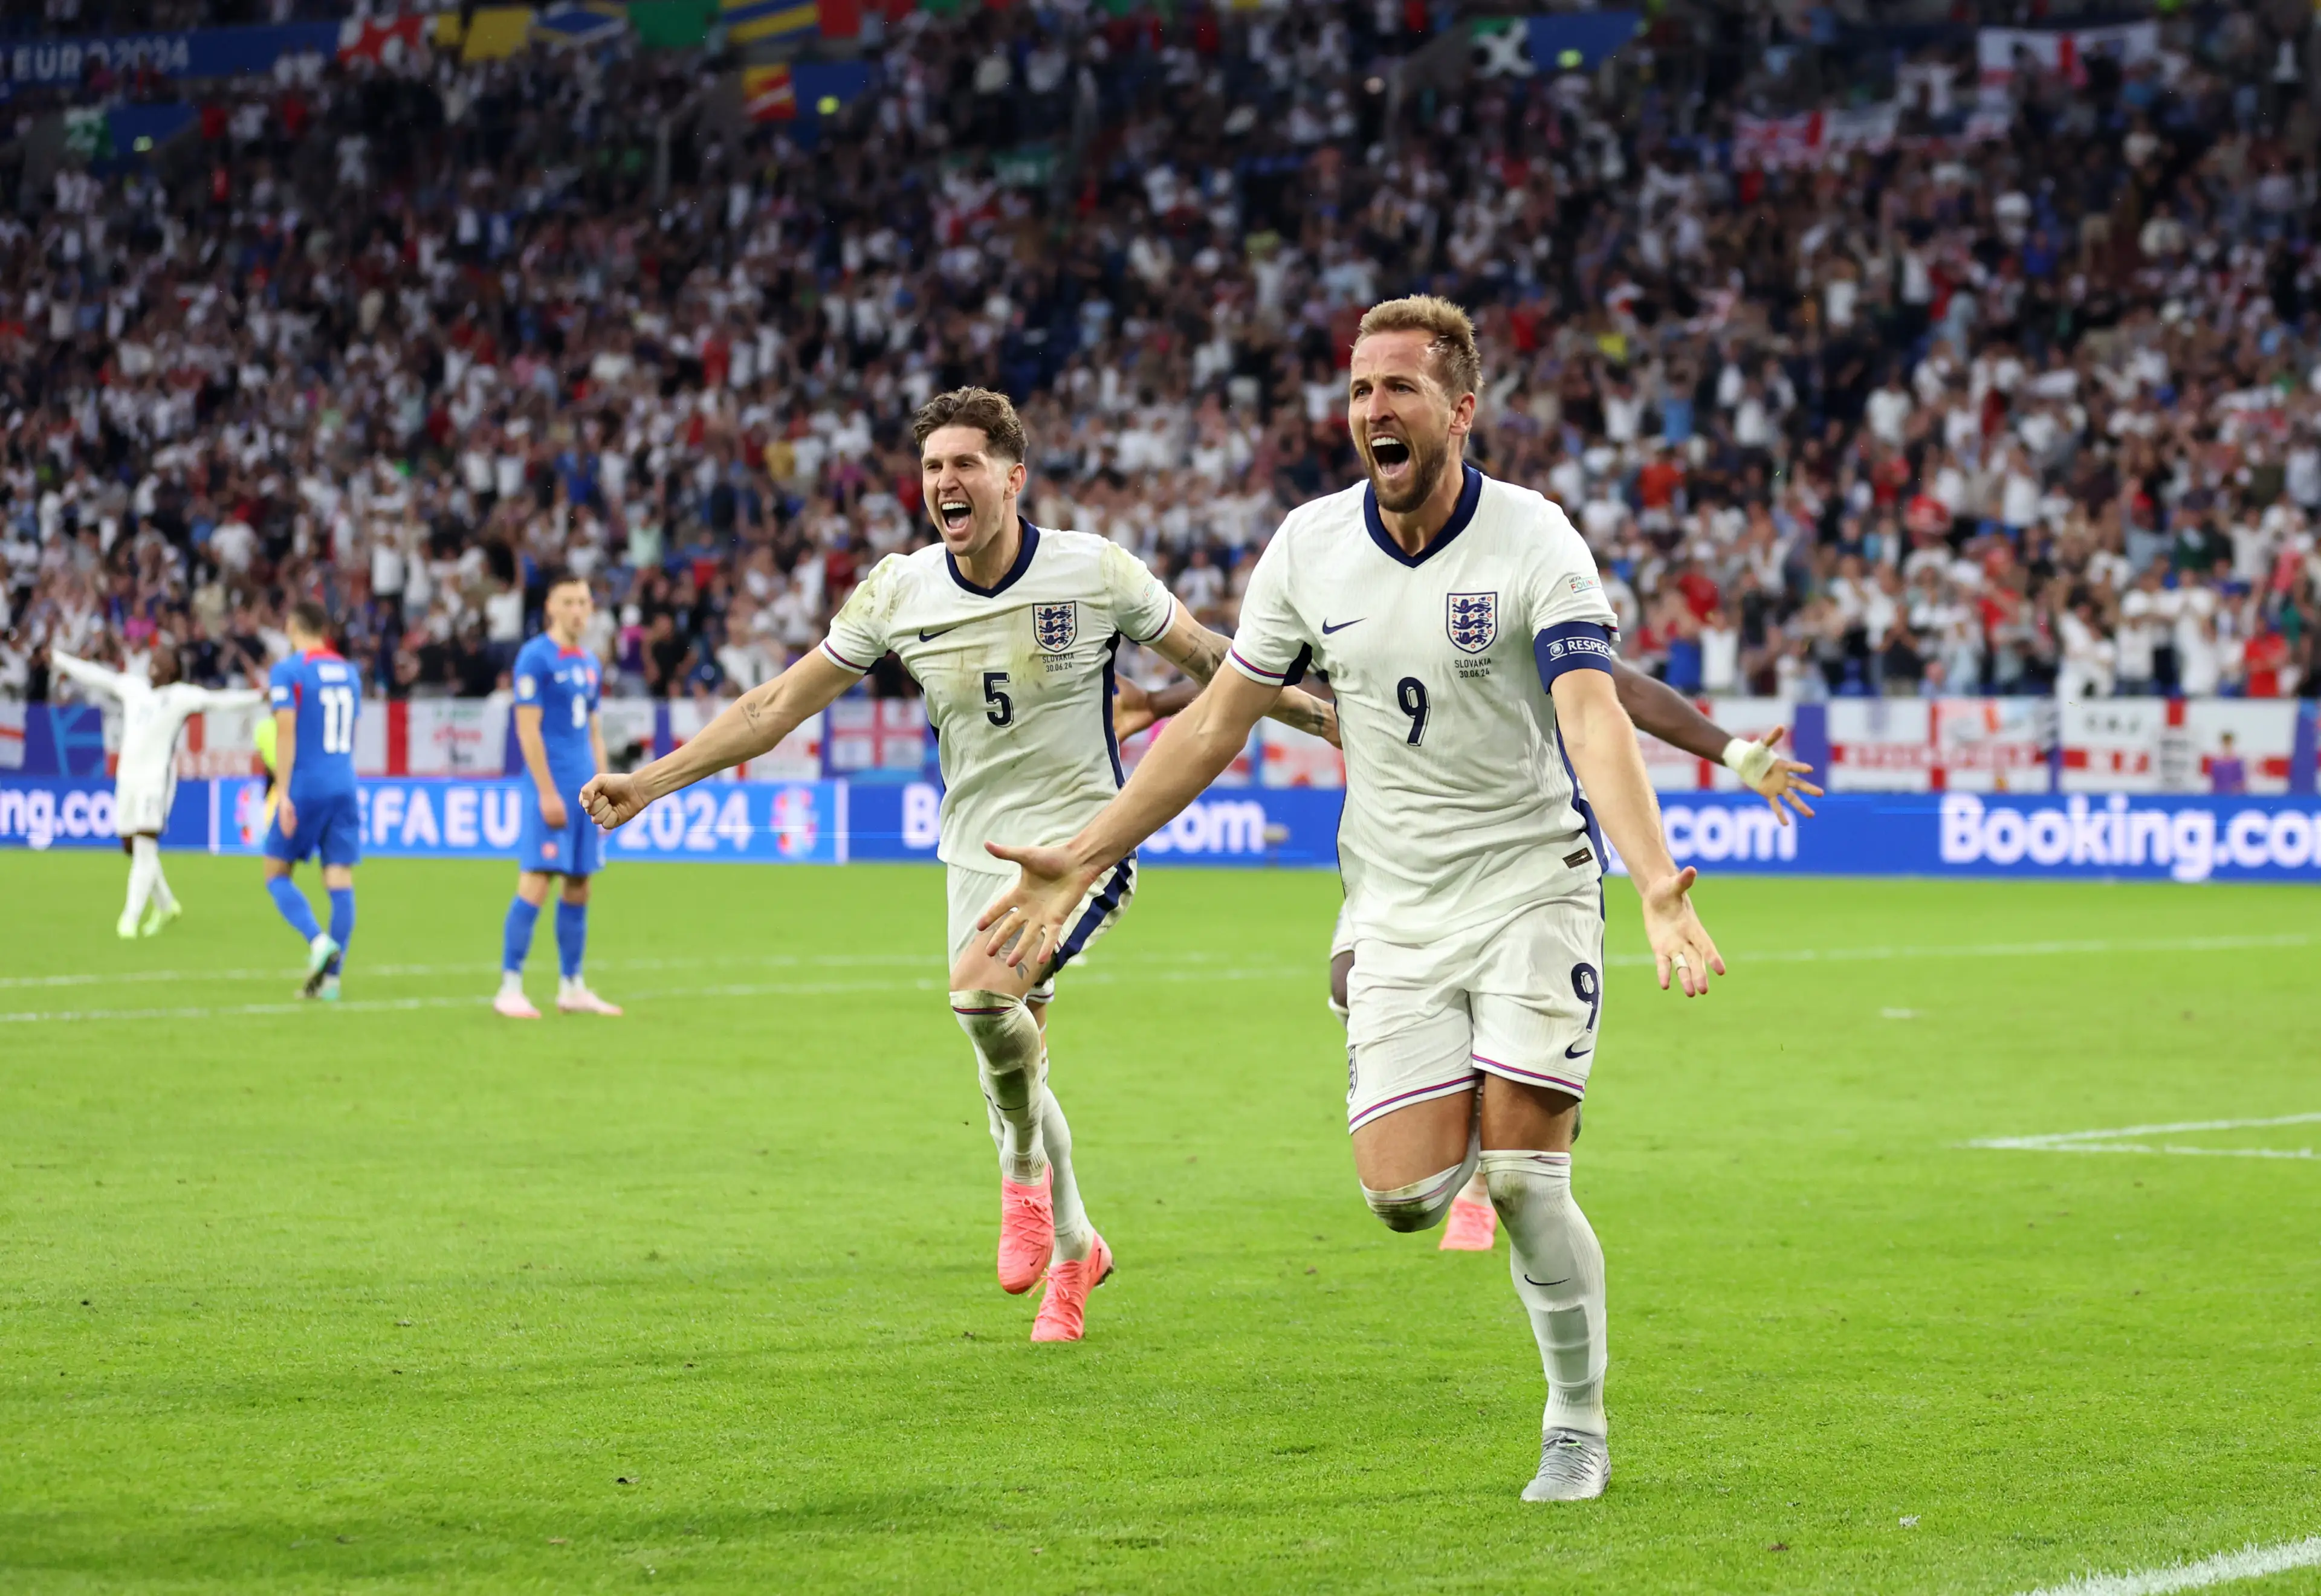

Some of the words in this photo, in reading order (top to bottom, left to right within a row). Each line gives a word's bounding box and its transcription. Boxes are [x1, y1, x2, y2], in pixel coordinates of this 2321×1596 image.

[1042, 653, 1075, 664] SLOVAKIA
[1046, 662, 1073, 673] 30.06.24
[1454, 657, 1492, 668] SLOVAKIA
[1458, 668, 1491, 679] 30.06.24
[318, 686, 355, 754] 11
[983, 672, 1014, 728] 5
[1397, 676, 1431, 747] 9
[1940, 791, 2321, 883] Booking.co
[1570, 962, 1601, 1033] 9
